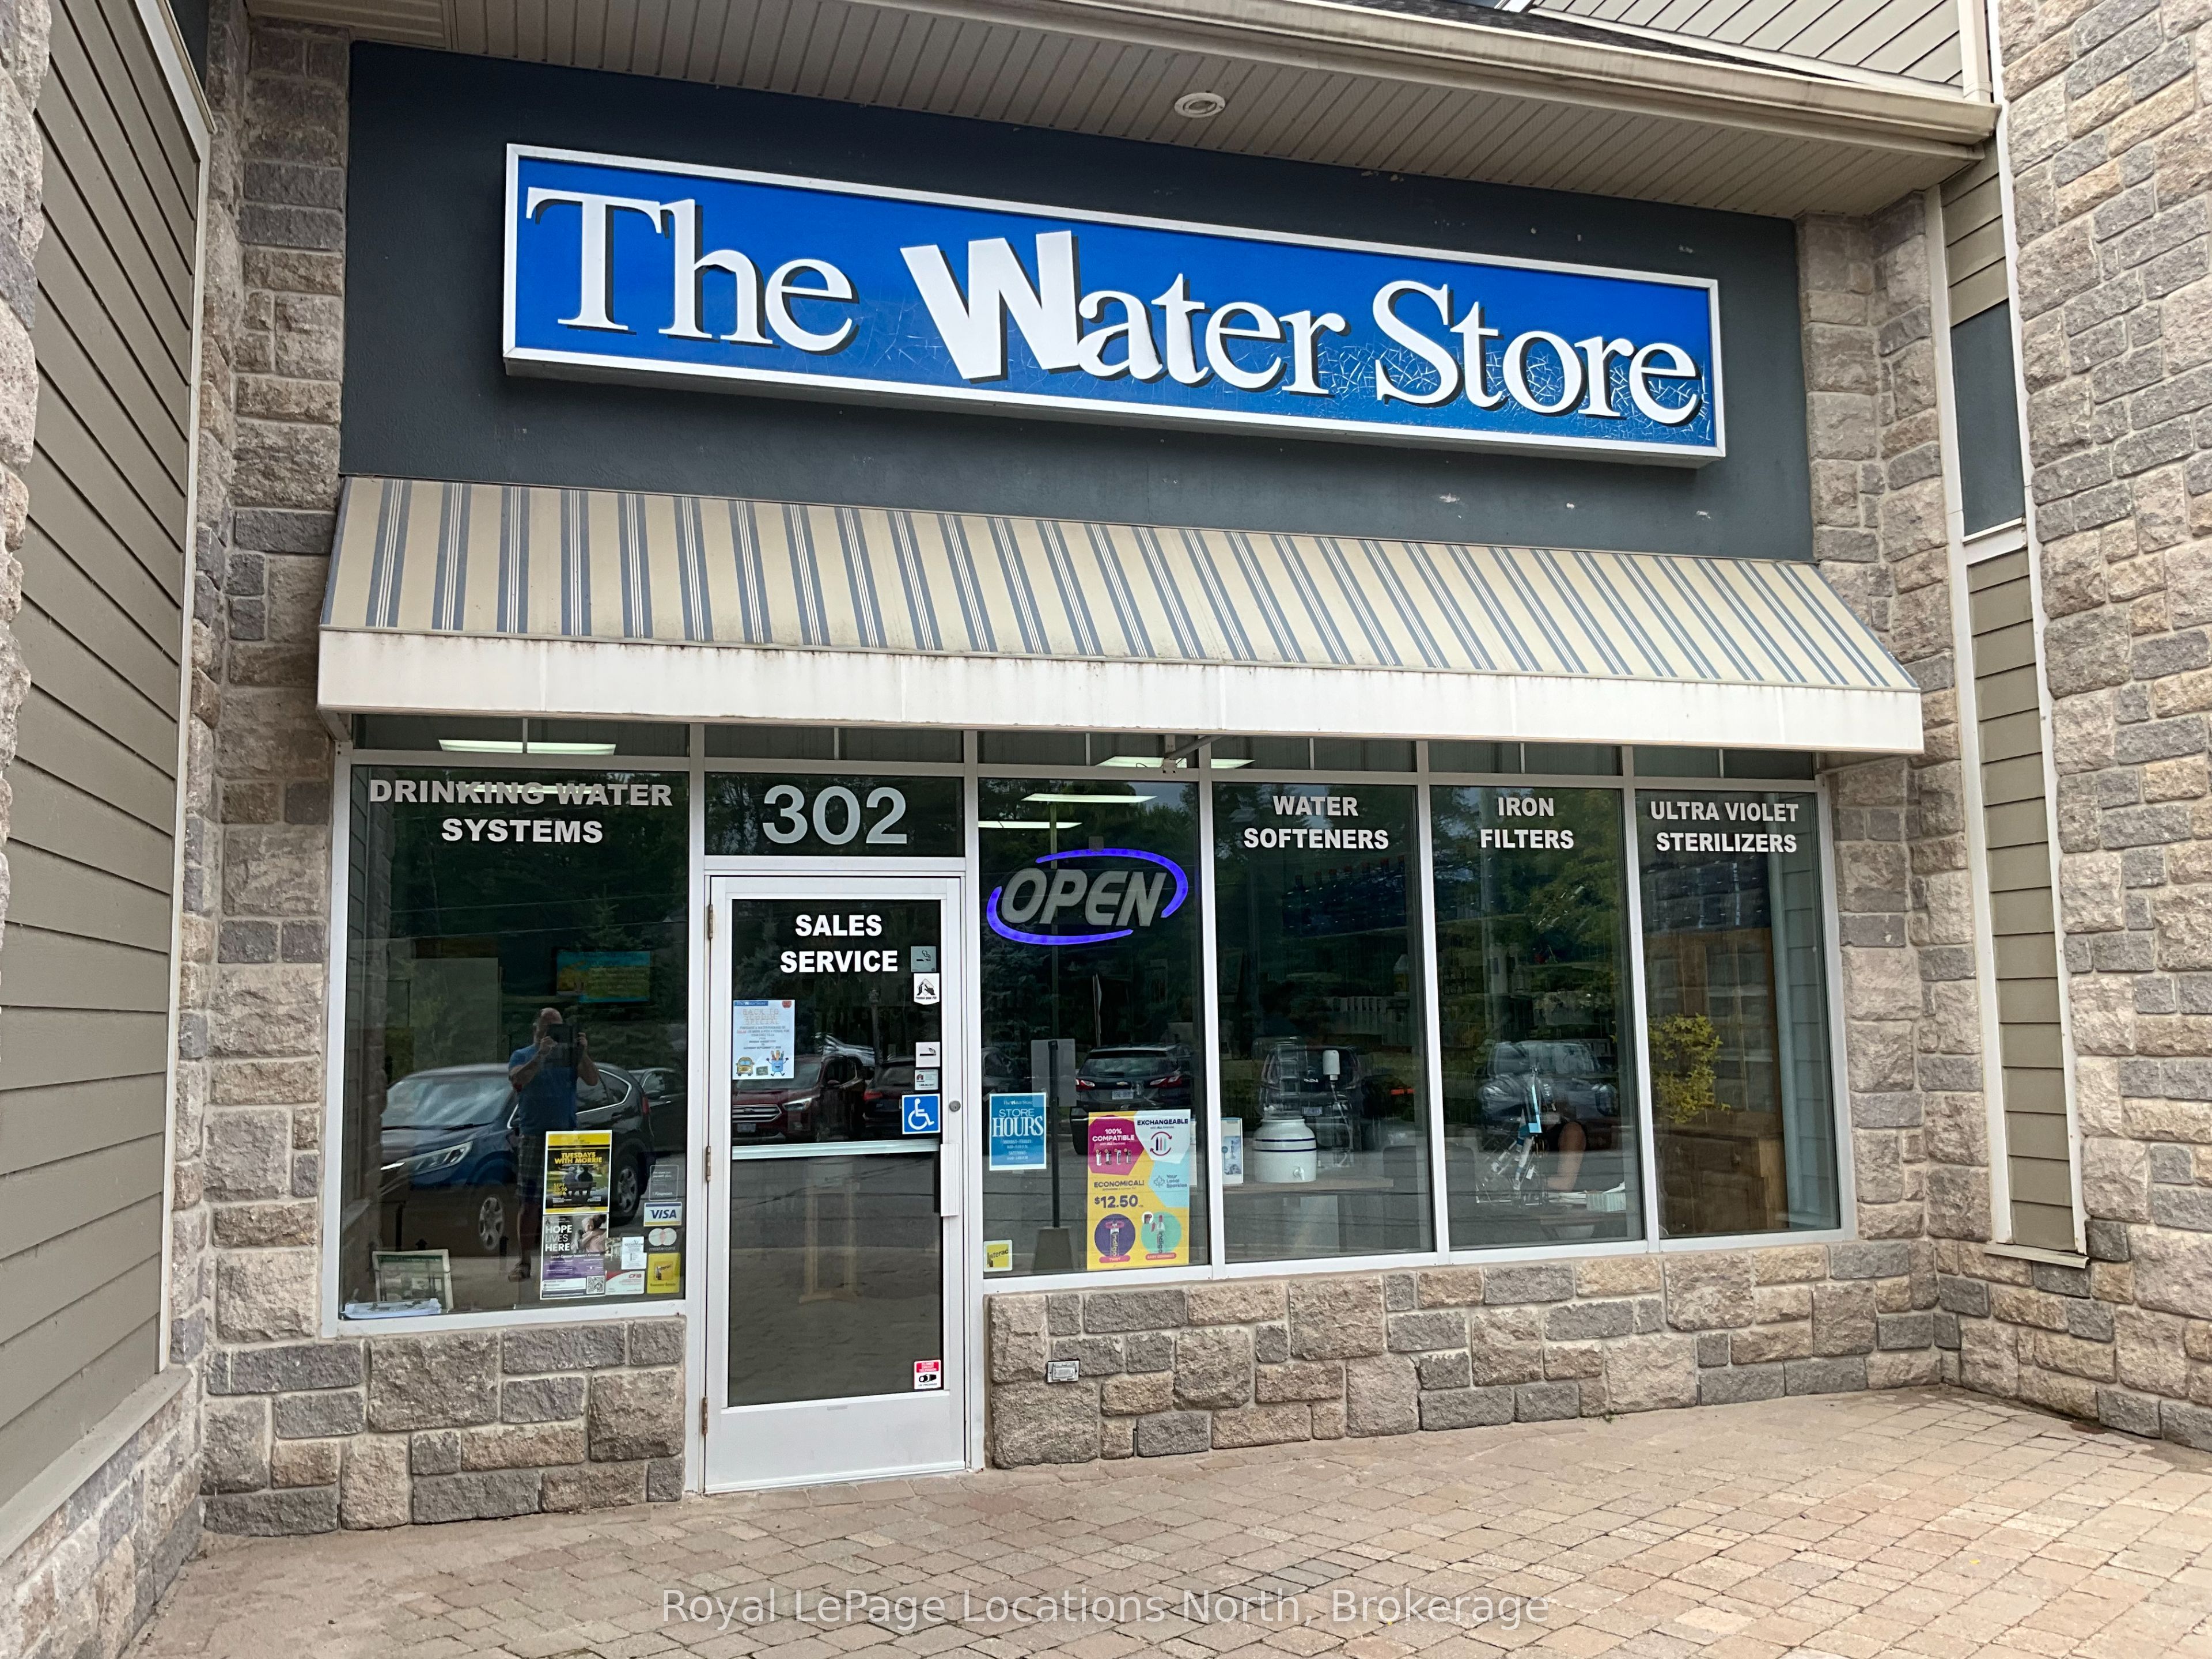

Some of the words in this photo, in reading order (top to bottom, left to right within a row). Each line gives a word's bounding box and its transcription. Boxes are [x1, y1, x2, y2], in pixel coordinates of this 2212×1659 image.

[526, 187, 855, 353] The
[900, 230, 1348, 395] Water
[1373, 280, 1699, 425] Store
[370, 779, 544, 805] DRINKING
[555, 782, 673, 806] WATER
[762, 785, 907, 845] 302
[1272, 796, 1359, 816] WATER
[1498, 797, 1554, 816] IRON
[1650, 801, 1719, 820] ULTRA
[1725, 802, 1798, 821] VIOLET
[442, 818, 603, 843] SYSTEMS
[1244, 828, 1389, 850] SOFTENERS
[1480, 829, 1574, 849] FILTERS
[1656, 832, 1797, 853] STERILIZERS
[1001, 868, 1167, 927] OPEN
[795, 914, 882, 937] SALES
[780, 950, 898, 974] SERVICE
[999, 1108, 1035, 1117] STORE
[992, 1115, 1044, 1137] HOURS
[1092, 1134, 1135, 1142] COMPATIBLE
[1094, 1179, 1145, 1188] ECONOMICAL!
[1094, 1195, 1138, 1209] $12.50
[650, 1209, 677, 1219] VISA
[545, 1225, 573, 1233] HOPE
[545, 1234, 569, 1243] LIVES
[545, 1243, 570, 1252] HERE
[987, 1249, 1009, 1267] Interac
